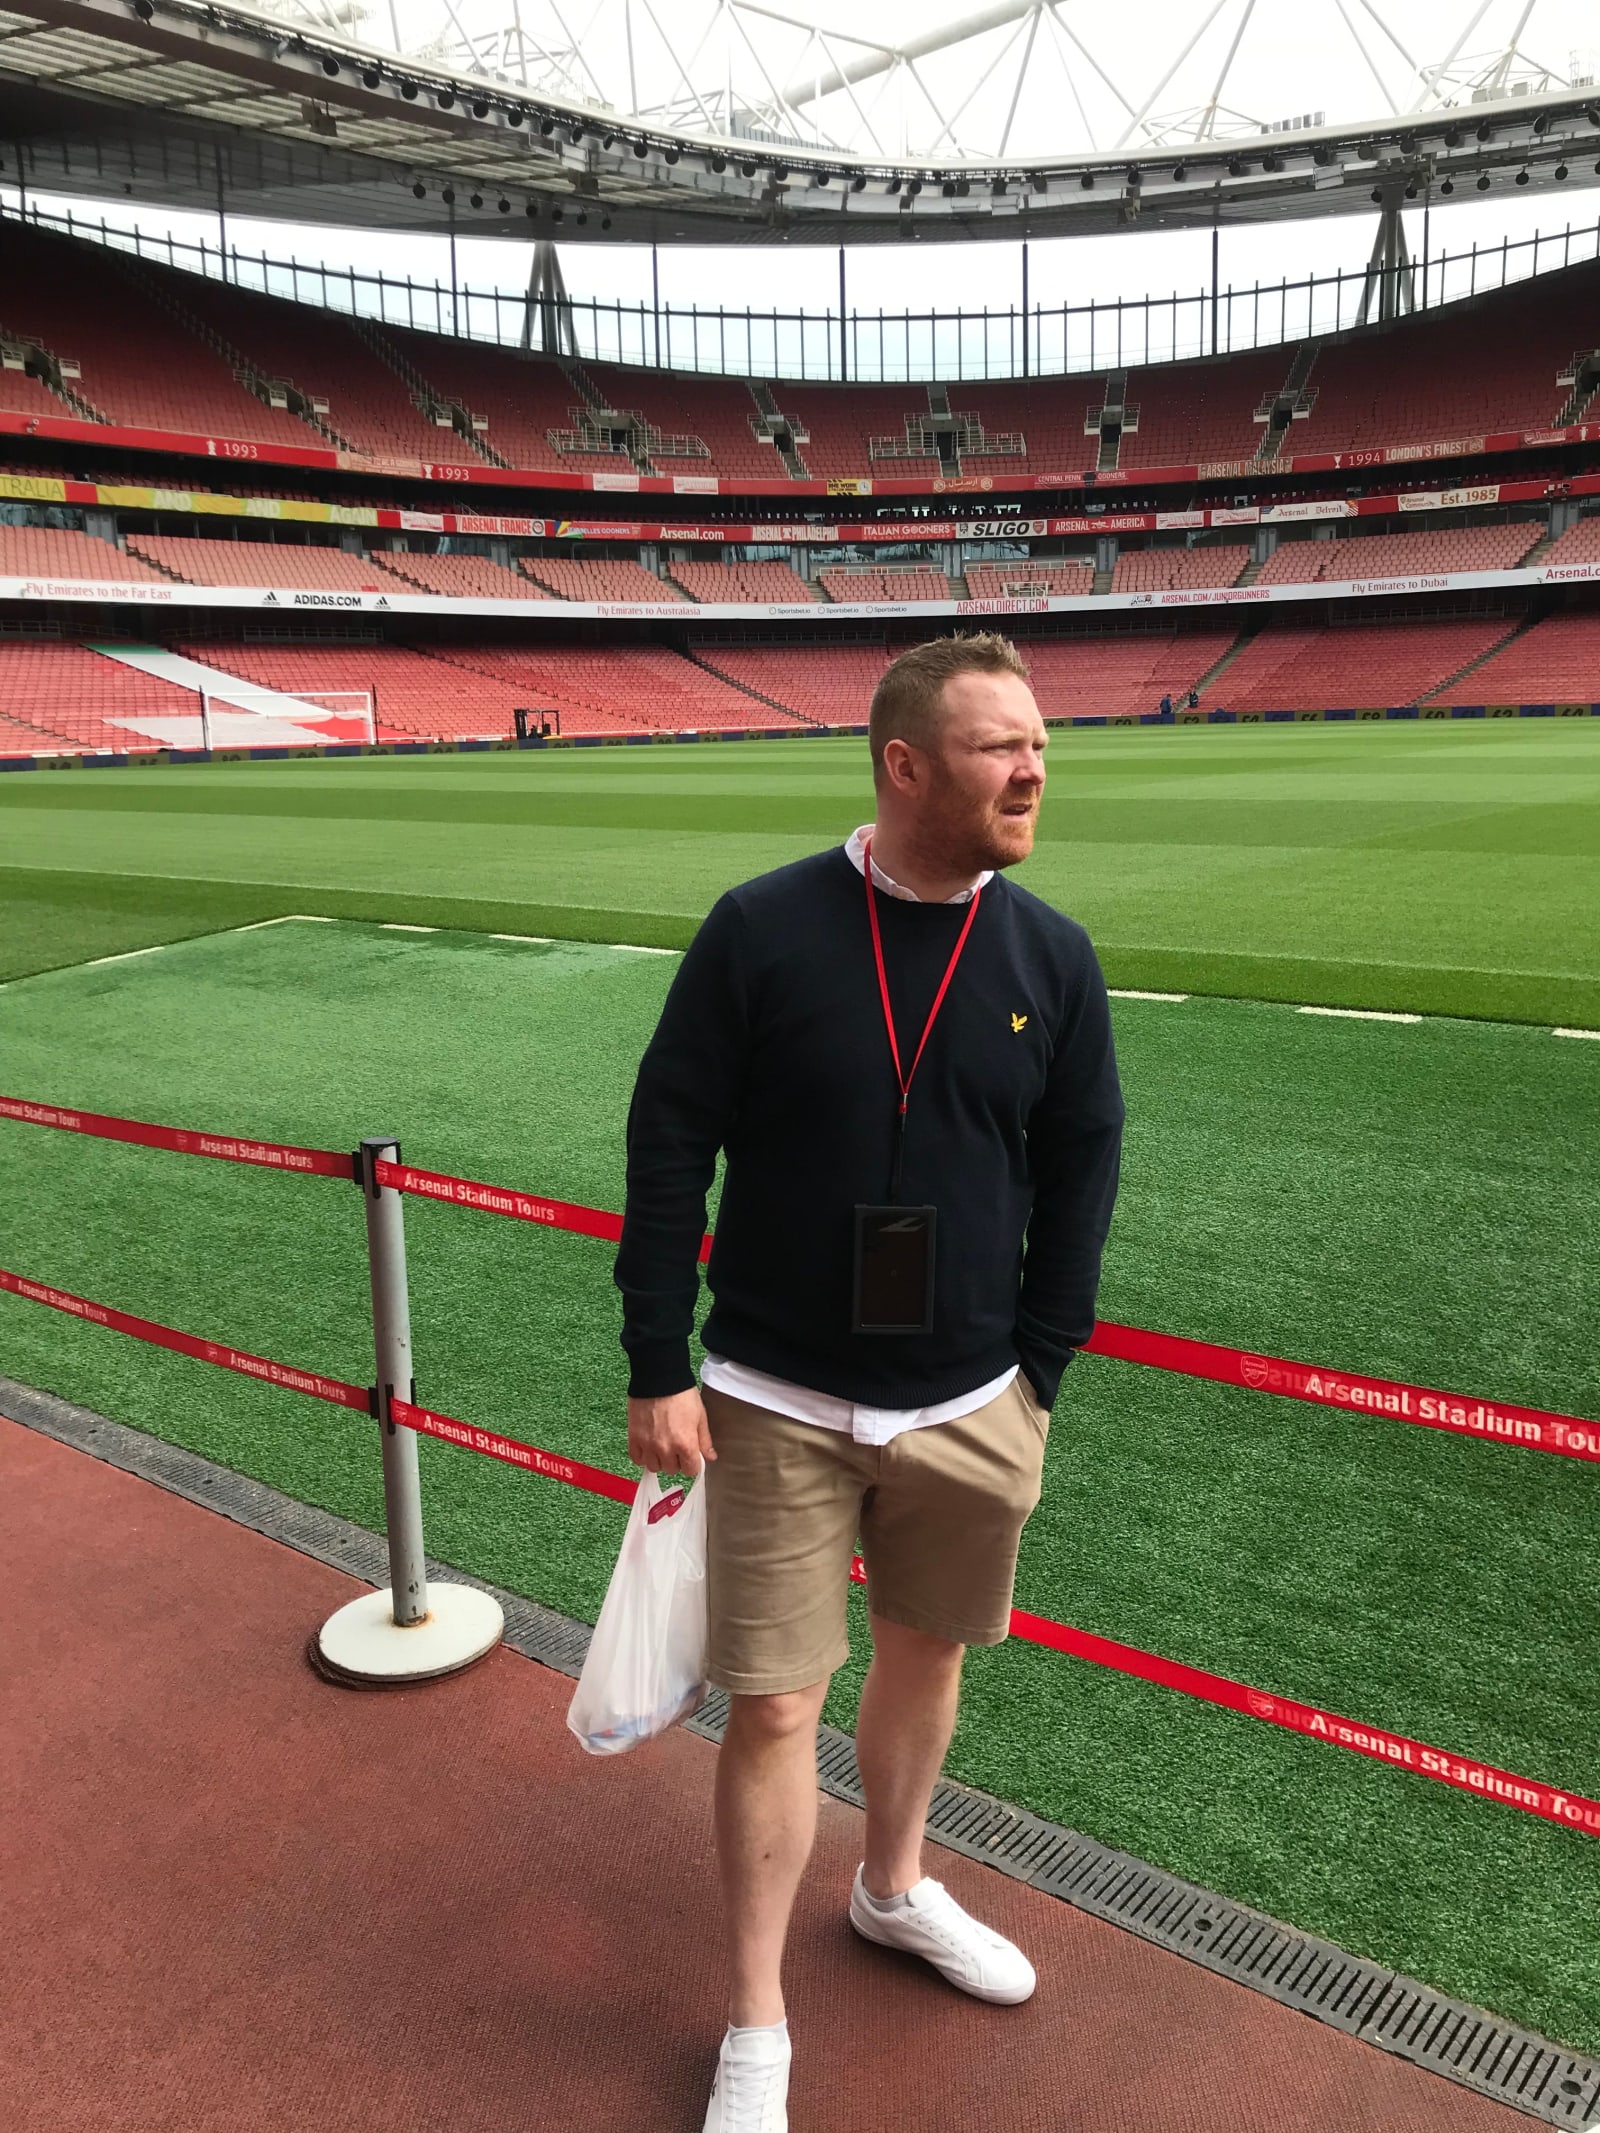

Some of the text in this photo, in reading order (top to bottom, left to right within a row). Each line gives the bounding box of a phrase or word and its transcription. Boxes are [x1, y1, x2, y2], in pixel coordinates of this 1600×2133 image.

[223, 442, 258, 459] 1993
[1348, 452, 1381, 466] 1994
[1385, 440, 1469, 462] LONDON'S FINEST
[437, 467, 470, 481] 1993
[1206, 458, 1285, 479] ARSENAL MALAYSIA
[1466, 488, 1497, 502] 1985
[246, 497, 281, 518] AND
[331, 505, 375, 526] AGAIN
[1278, 504, 1342, 516] Arsenal Detroit
[461, 516, 498, 533] ARSENAL
[500, 518, 532, 535] FRANCE
[863, 524, 950, 536] ITALIAN GOONERS
[973, 522, 1030, 536] SLIGO
[1055, 517, 1145, 532] ARSENAL AMERICA
[660, 527, 725, 540] Arsenal.com
[26, 582, 172, 600] Fly Emirates to the Far East
[1352, 578, 1448, 594] Fly Emirates to Dubai
[294, 594, 362, 607] ADIDAS.COM
[956, 599, 1049, 615] ARSENALDIRECT.COM
[597, 605, 609, 616] Fly
[611, 606, 643, 615] Emirates
[645, 607, 654, 615] to
[0, 1102, 81, 1128] rsenal Stadium Tours
[200, 1138, 313, 1169] Arsenal Stadium Tours
[404, 1172, 555, 1222] Arsenal Stadium Tours
[18, 1280, 108, 1323] Arsenal Stadium Tours
[230, 1353, 347, 1402] Arsenal Stadium Tours
[1304, 1373, 1411, 1416] Arsenal
[1419, 1395, 1542, 1442] Stadium
[1549, 1422, 1600, 1455] Tou
[424, 1414, 574, 1480] Arsenal Stadium Tours
[1310, 1714, 1414, 1765] Arsenal
[1420, 1750, 1540, 1808] Stadium
[1549, 1793, 1600, 1829] Tou
